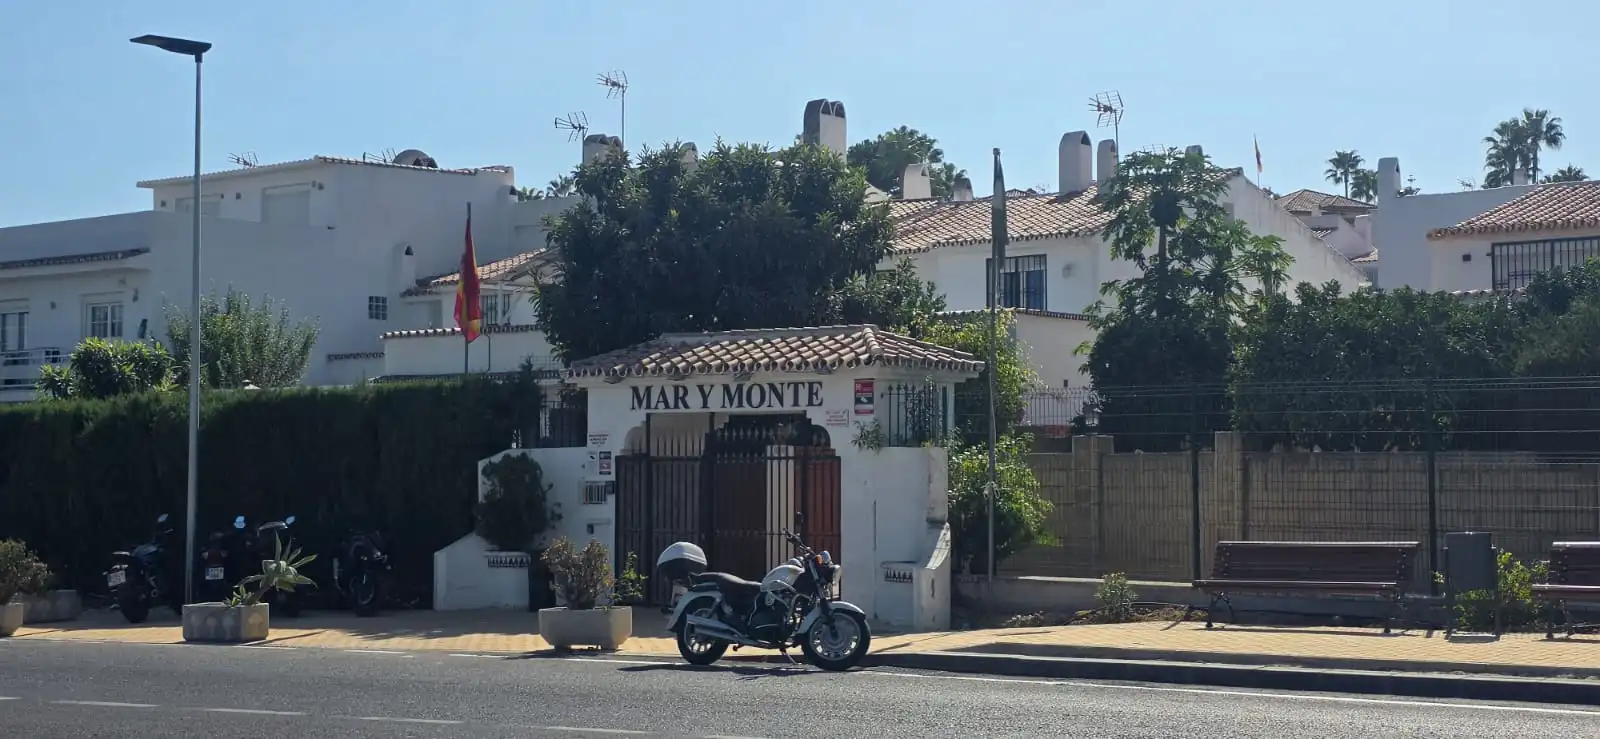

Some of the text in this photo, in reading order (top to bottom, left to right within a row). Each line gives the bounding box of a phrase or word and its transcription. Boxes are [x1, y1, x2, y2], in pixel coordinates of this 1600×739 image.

[630, 384, 691, 411] MAR
[696, 384, 715, 409] Y
[720, 381, 824, 409] MONTE
